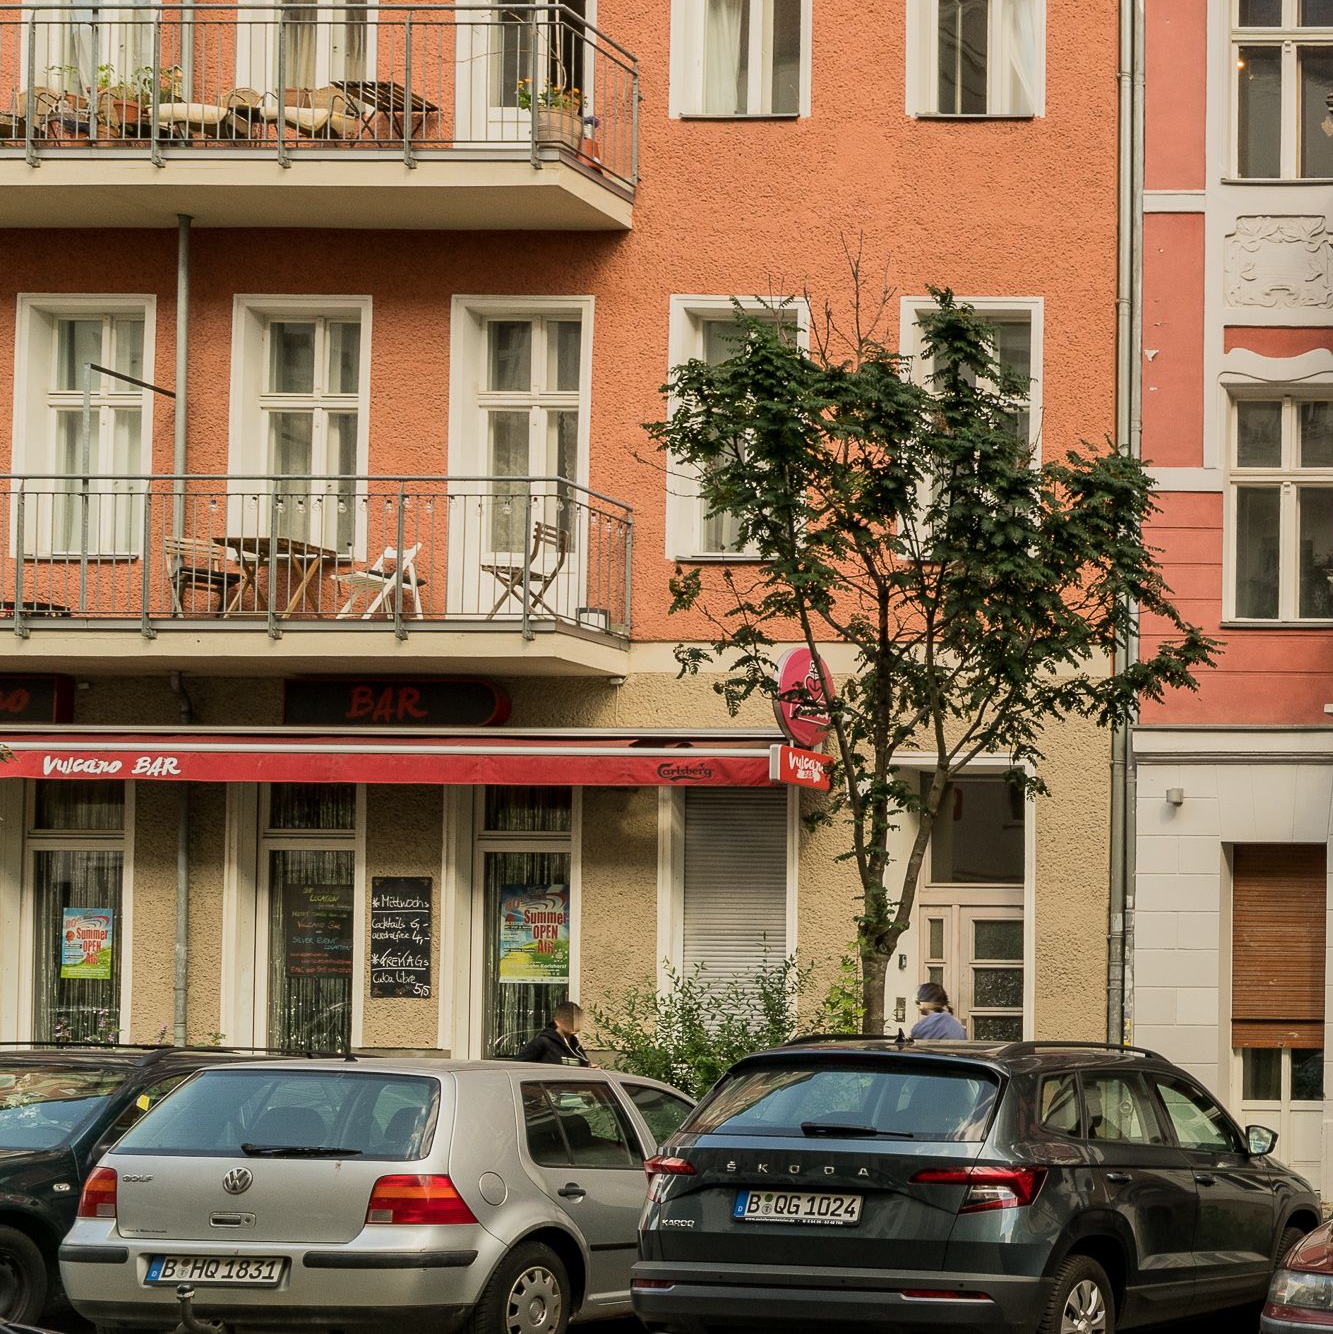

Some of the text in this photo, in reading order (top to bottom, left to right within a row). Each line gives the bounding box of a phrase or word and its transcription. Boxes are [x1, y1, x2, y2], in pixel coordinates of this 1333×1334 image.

[345, 685, 428, 722] BAR
[43, 755, 181, 776] Vulcano BAR
[657, 763, 713, 782] Carlsberg
[523, 909, 566, 925] Summer
[77, 927, 108, 940] Summer
[533, 924, 559, 940] OPEN
[747, 1195, 761, 1213] B
[804, 1196, 856, 1217] 1024
[160, 1259, 277, 1280] B HQ 1831
